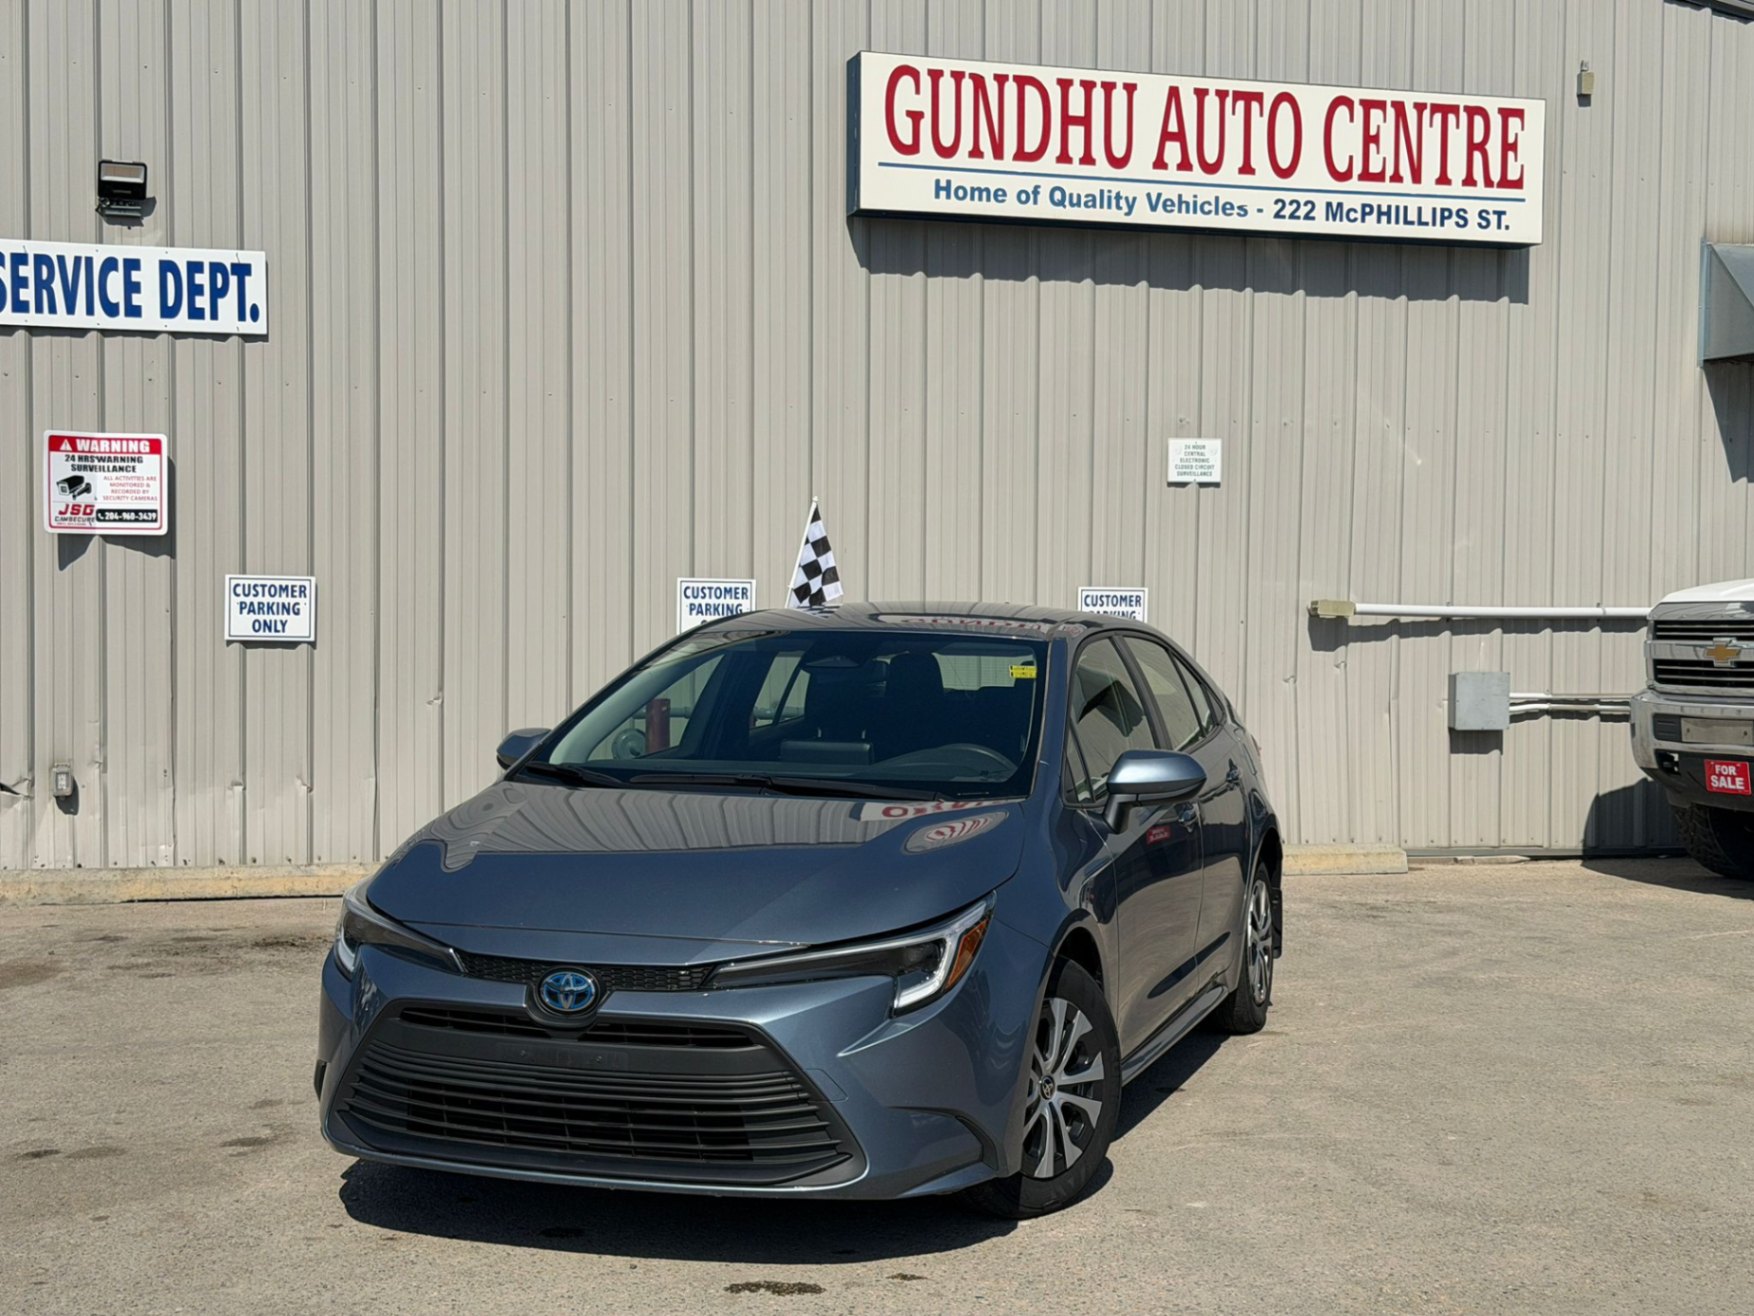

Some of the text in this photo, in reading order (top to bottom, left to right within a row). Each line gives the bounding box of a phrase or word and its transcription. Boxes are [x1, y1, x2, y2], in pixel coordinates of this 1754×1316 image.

[885, 64, 1525, 190] GUNDHU AUTO CENTRE
[934, 178, 1008, 204] Home
[1016, 185, 1042, 206] of
[1049, 186, 1137, 217] Quality
[1146, 192, 1249, 218] Vehicles
[1273, 198, 1317, 221] 222
[1324, 201, 1469, 229] McPHILLIPS
[1477, 209, 1511, 231] ST.
[159, 259, 260, 323] DEPT.
[76, 439, 150, 453] WARNING
[65, 454, 76, 462] 24
[71, 464, 137, 473] SURVEILLANCE
[58, 503, 95, 516] JSG
[232, 583, 307, 599] CUSTOMER
[683, 585, 749, 600] CUSTOMER
[1084, 594, 1142, 607] CUSTOMER
[239, 601, 301, 616] PARKING
[688, 602, 743, 617] PARKING
[252, 618, 288, 633] ONLY
[1714, 764, 1737, 776] FOR
[1710, 775, 1745, 790] SALE
